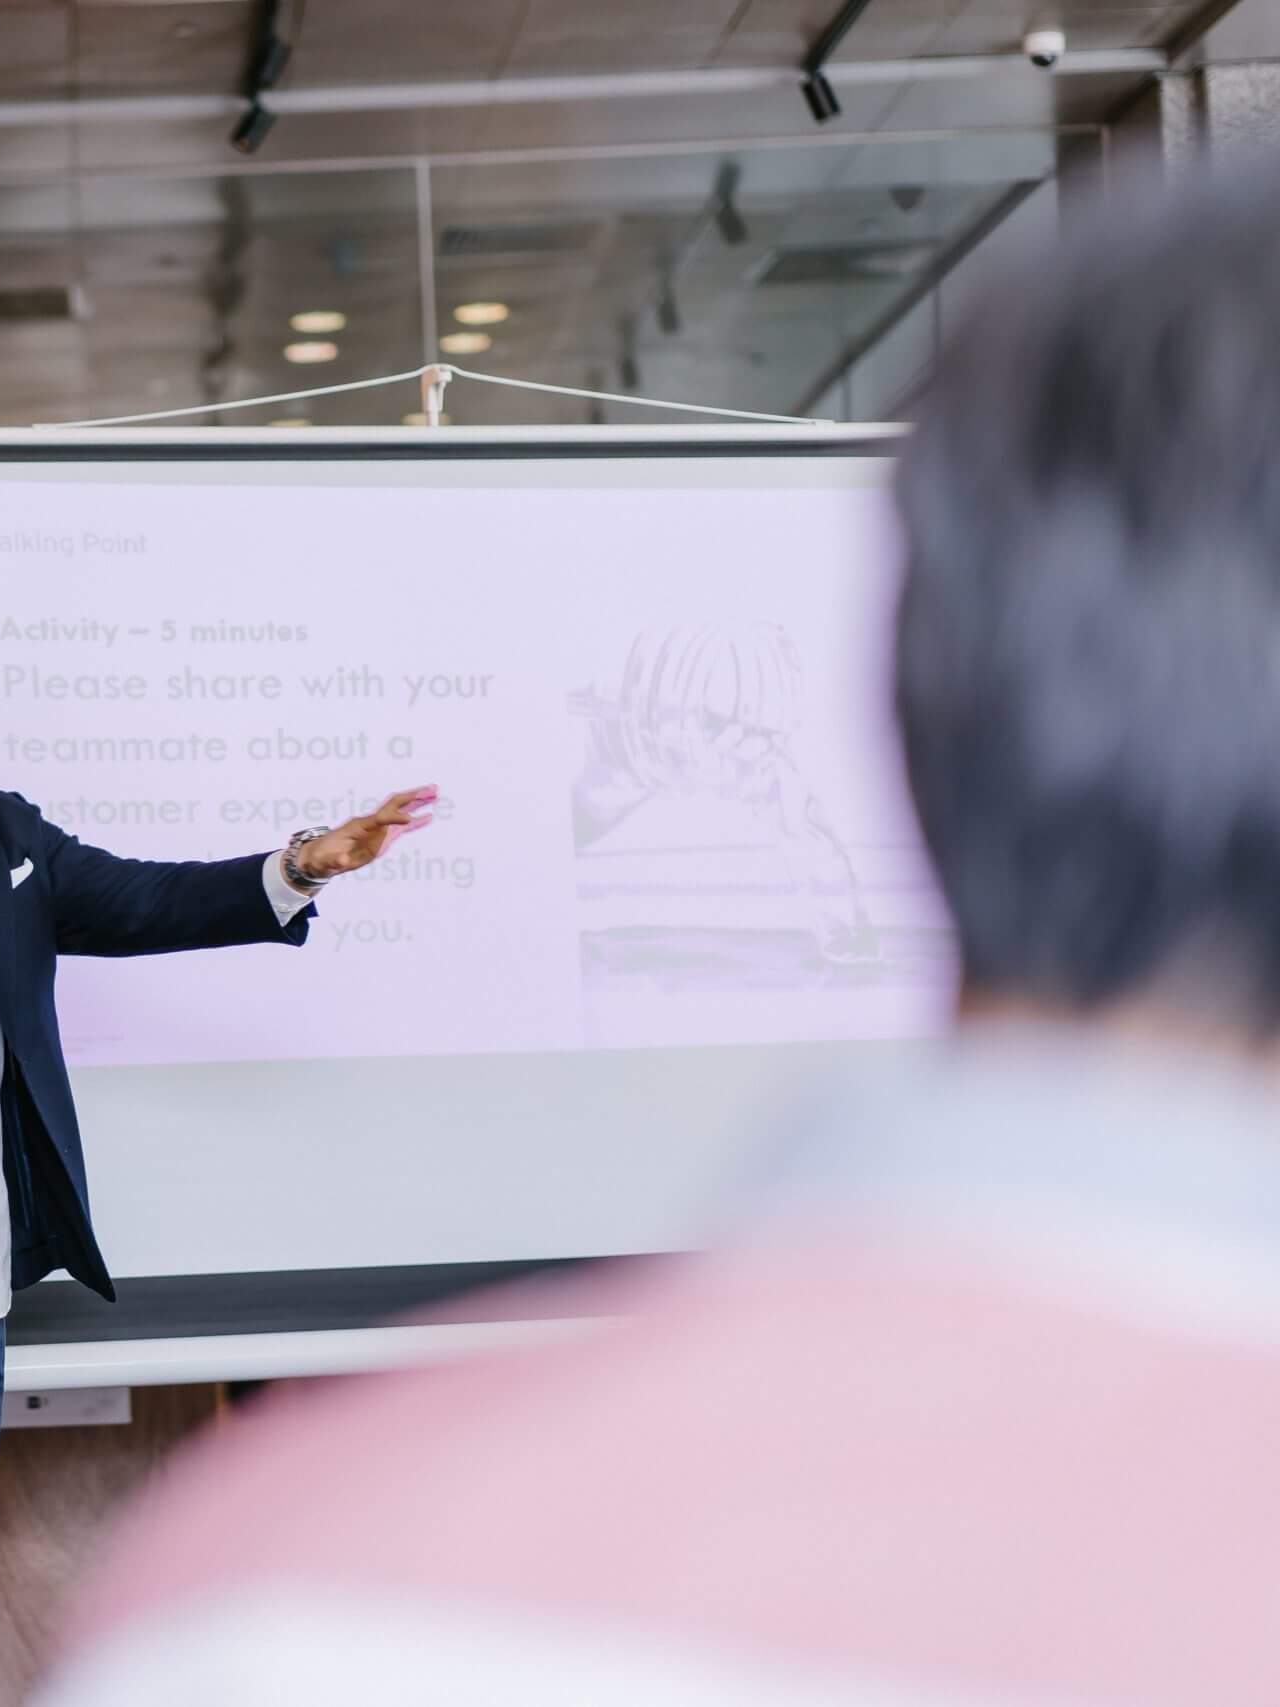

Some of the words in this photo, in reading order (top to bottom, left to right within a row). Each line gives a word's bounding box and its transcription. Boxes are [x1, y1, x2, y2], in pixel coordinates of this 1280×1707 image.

[82, 530, 149, 554] Point
[0, 617, 120, 648] Activity
[159, 618, 177, 643] 5
[191, 618, 309, 643] minutes
[2, 663, 148, 700] Please
[168, 664, 282, 700] share
[298, 663, 384, 699] with
[401, 673, 495, 711] your
[4, 731, 228, 762] teammate
[247, 727, 369, 761] about
[387, 735, 414, 761] a
[46, 794, 201, 826] stomer
[220, 787, 456, 831] experiee
[341, 847, 476, 889] asting
[327, 919, 416, 952] you.
